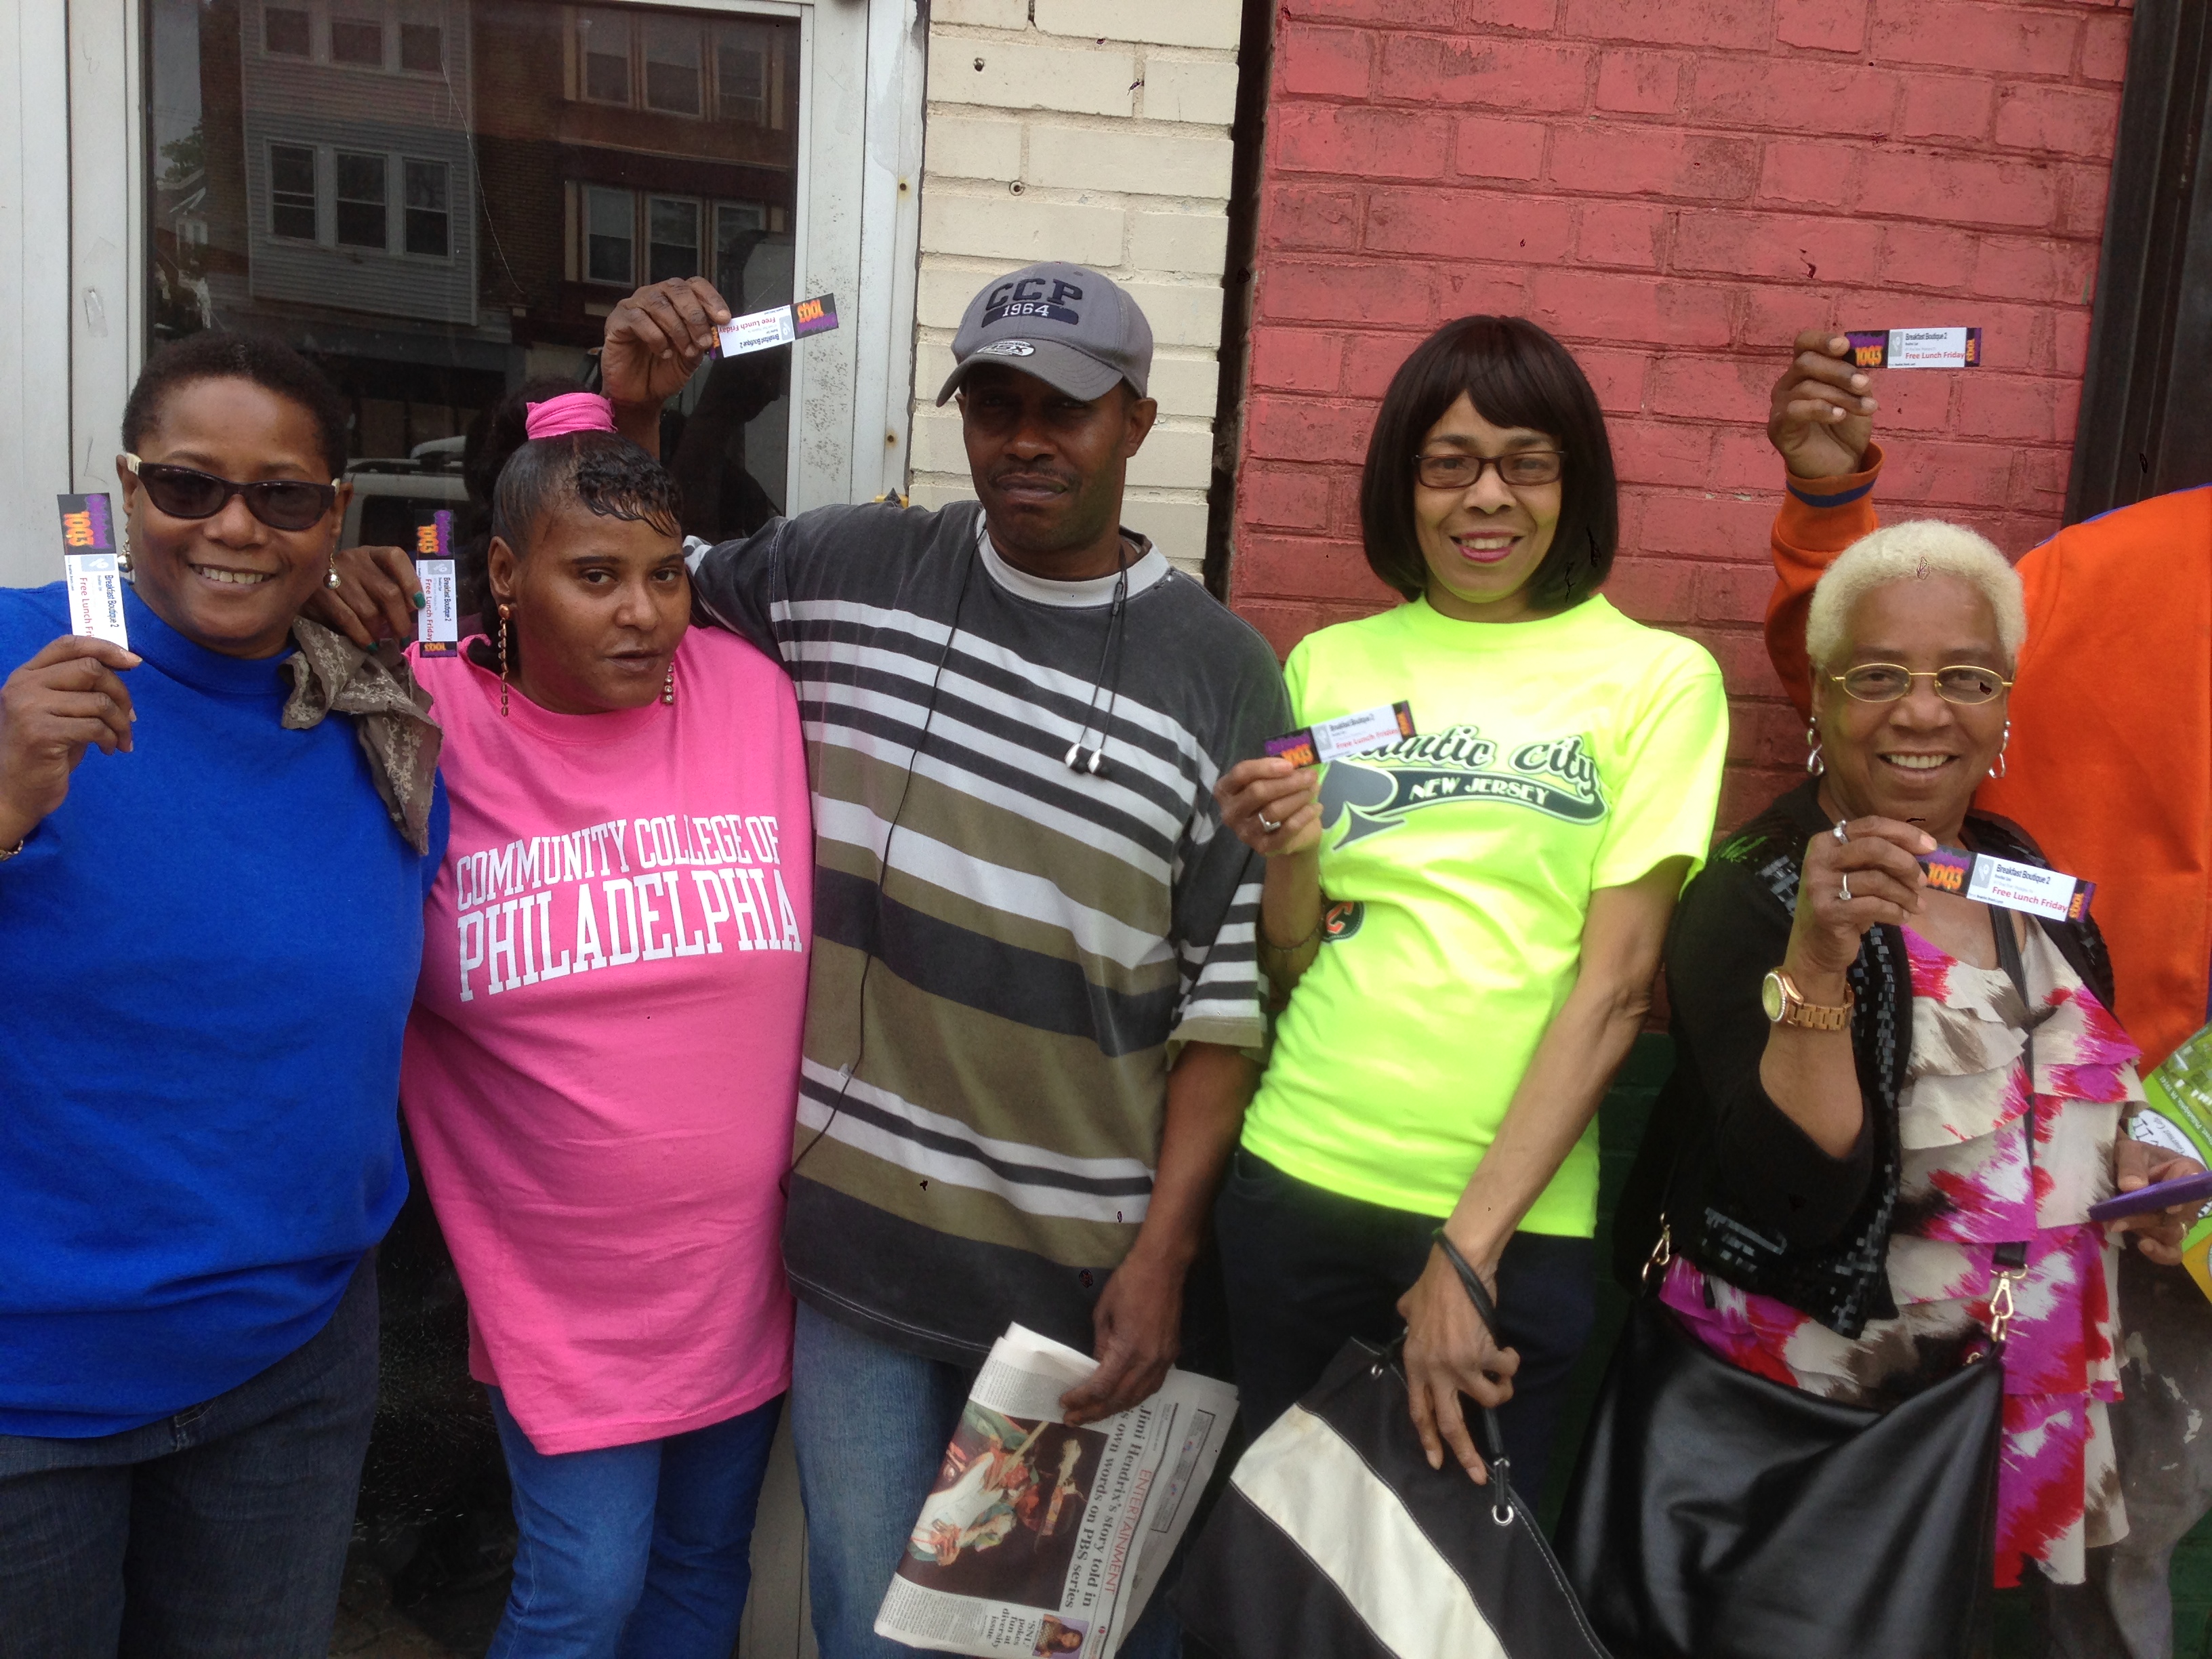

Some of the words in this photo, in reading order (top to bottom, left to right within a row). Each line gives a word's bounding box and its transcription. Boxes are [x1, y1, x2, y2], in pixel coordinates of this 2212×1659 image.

[985, 277, 1083, 311] CCP
[761, 316, 776, 325] Free
[1002, 303, 1050, 318] 1964
[719, 325, 739, 334] Friday
[740, 321, 760, 329] Lunch
[760, 333, 780, 344] Breakfast
[1921, 351, 1942, 359] Lunch
[1943, 351, 1965, 360] Friday
[79, 577, 88, 596] Free
[104, 575, 116, 600] Breakfast
[443, 577, 451, 598] Breakfast
[81, 598, 92, 623] Lunch
[1513, 738, 1597, 798] City
[1409, 777, 1460, 800] NEW
[1465, 778, 1549, 805] JERSEY
[457, 819, 629, 912] COMMUNITY
[634, 815, 753, 869] COLLEGE
[744, 816, 780, 865] OF
[1996, 863, 2022, 878] Breakfast
[2022, 870, 2047, 885] Boutique
[1992, 886, 2011, 898] Free
[2013, 888, 2040, 905] Lunch
[2041, 899, 2068, 913] Friday
[457, 867, 802, 1002] PHILADELPHIA
[1134, 1405, 1151, 1439] Jimi
[1109, 1423, 1126, 1452] own
[1094, 1458, 1114, 1501] words
[1109, 1443, 1142, 1513] Hendrix's
[1086, 1505, 1099, 1523] on
[1077, 1527, 1094, 1561] PBS
[1094, 1515, 1114, 1553] story
[1105, 1469, 1152, 1595] ENTERTAINMENT
[1065, 1563, 1083, 1608] series
[1087, 1558, 1103, 1588] told
[1082, 1592, 1097, 1607] in
[987, 1616, 999, 1640] issue
[991, 1608, 1010, 1650] diversity
[1008, 1616, 1019, 1633] fun
[1013, 1618, 1025, 1646] pokes
[1004, 1634, 1012, 1645] at
